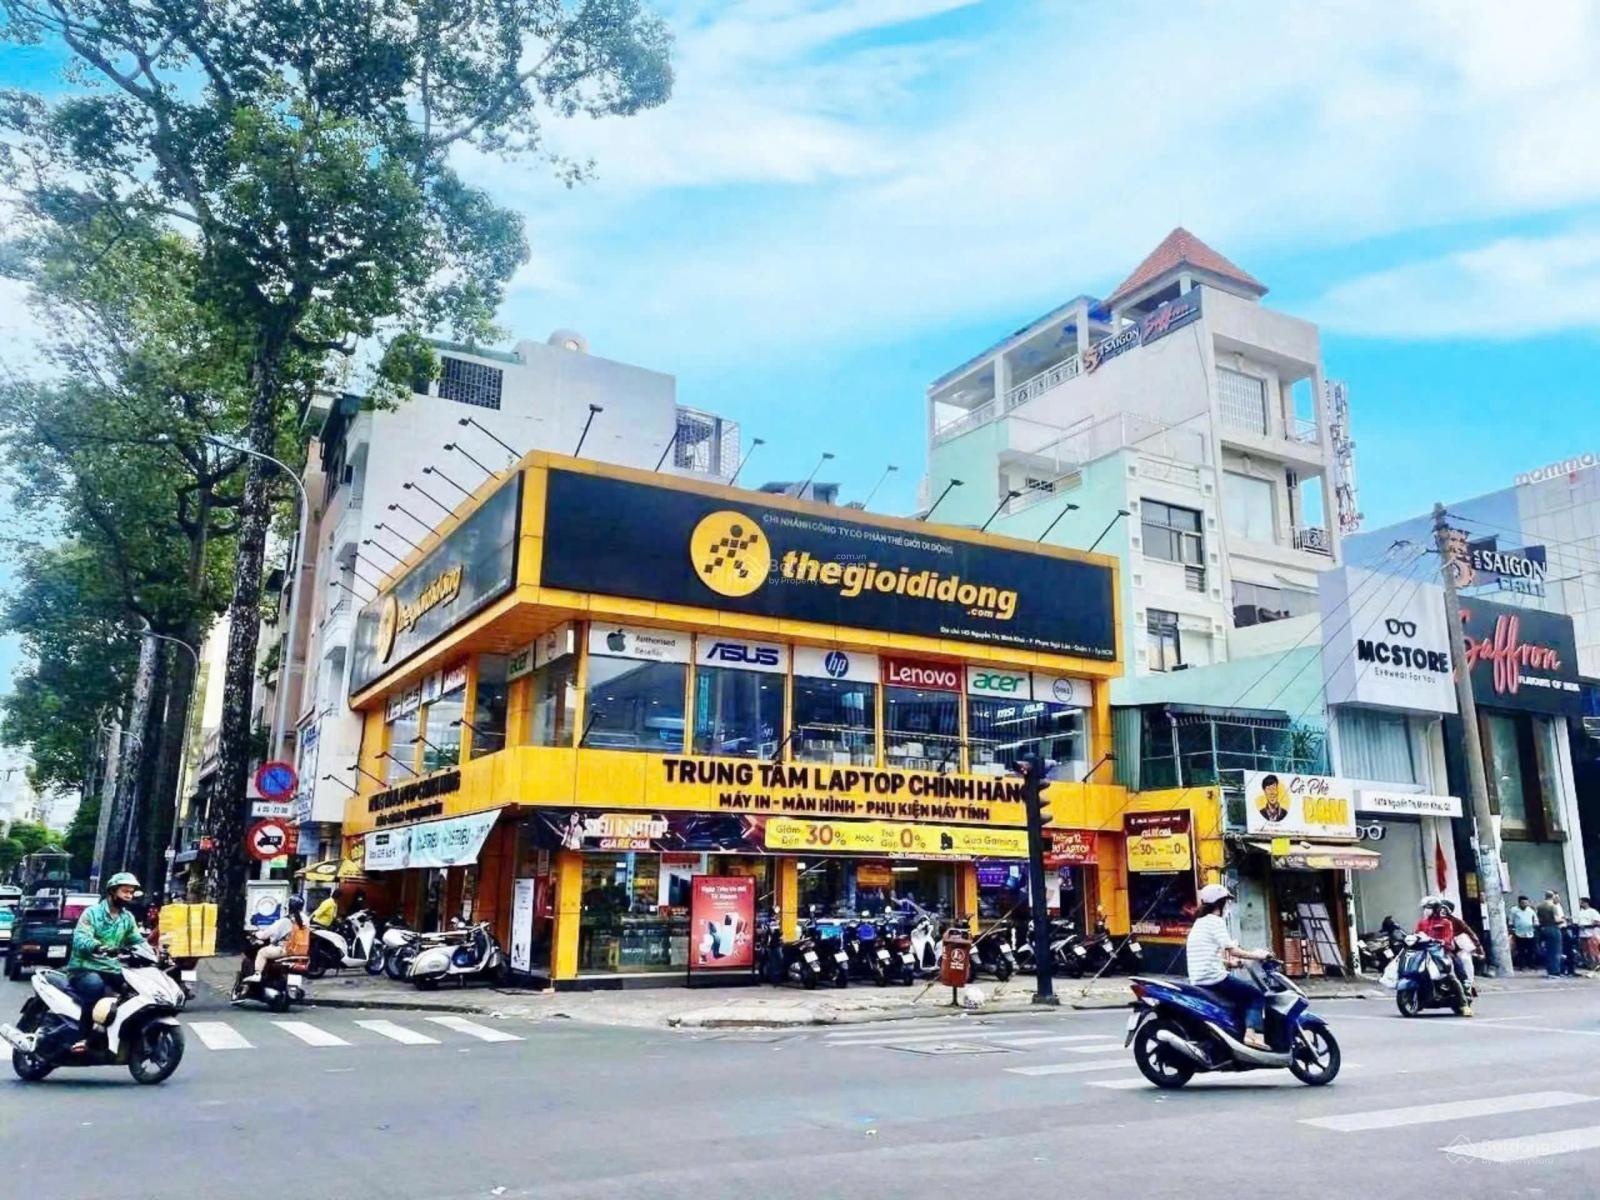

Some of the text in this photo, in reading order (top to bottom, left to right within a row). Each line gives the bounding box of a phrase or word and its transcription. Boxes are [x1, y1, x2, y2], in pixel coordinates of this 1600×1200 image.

[762, 514, 779, 524] CHI
[839, 526, 849, 536] TY
[1482, 549, 1547, 581] SAIGON
[782, 548, 1018, 620] thegioididong
[707, 642, 779, 666] ASUS
[828, 652, 847, 677] hp
[1357, 639, 1449, 673] MCSTORE
[890, 662, 957, 687] Lenovo
[972, 673, 1025, 692] acer
[662, 759, 753, 785] TRUNG
[758, 761, 808, 789] TÂM
[814, 768, 905, 794] LAPTOP
[908, 772, 975, 799] CHÍNH
[719, 790, 752, 808] MÁY
[754, 794, 771, 809] IN
[782, 793, 816, 811] MÀN
[819, 795, 856, 813] HÌNH
[866, 801, 896, 818] PHỤ
[898, 802, 930, 820] KIỆN
[931, 803, 959, 819] MÁY
[959, 804, 990, 820] TÍNH
[804, 824, 847, 846] 30%
[899, 827, 926, 849] 0%
[984, 836, 1019, 848] Gaming
